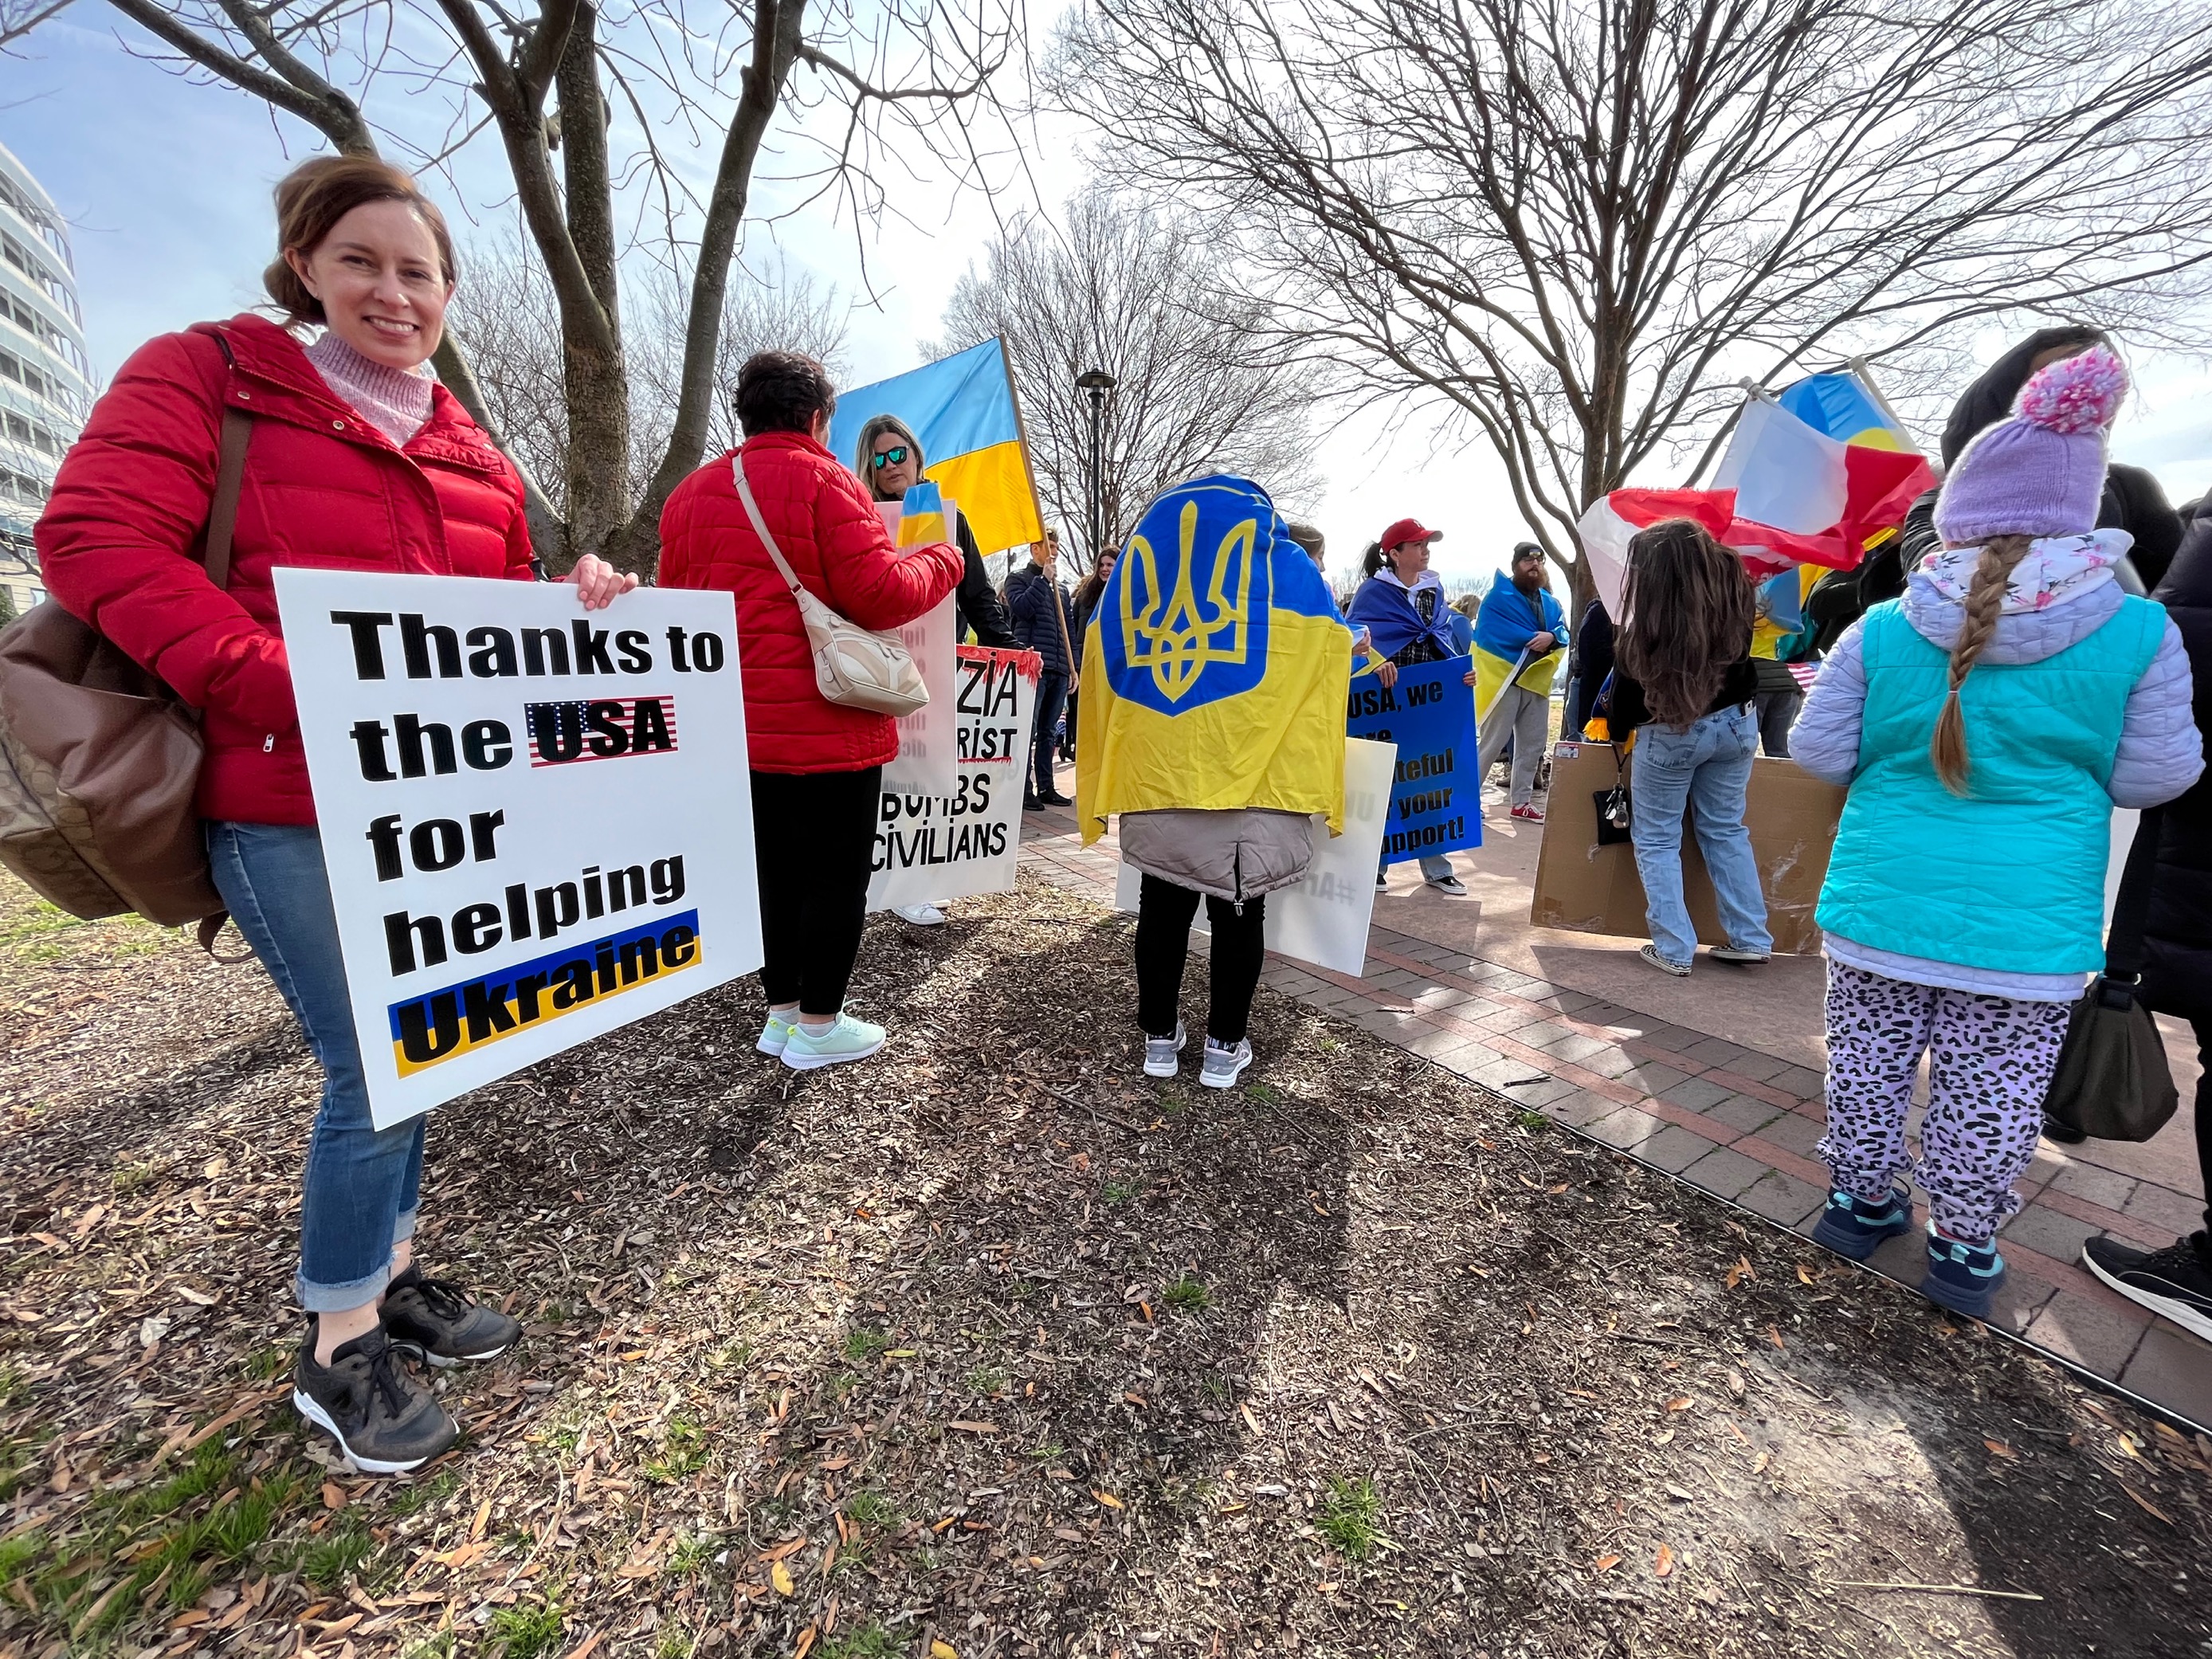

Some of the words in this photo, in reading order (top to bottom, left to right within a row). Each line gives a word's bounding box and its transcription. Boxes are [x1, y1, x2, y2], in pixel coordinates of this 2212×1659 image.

[331, 610, 653, 680] Thanks
[665, 626, 724, 673] to
[956, 652, 1018, 717] ZIA
[1406, 681, 1443, 708] we
[350, 713, 514, 782] the
[531, 699, 675, 763] USA
[957, 719, 1018, 759] RIST
[1393, 747, 1453, 783] teful
[1398, 786, 1453, 821] your
[365, 808, 505, 882] for
[871, 818, 1008, 873] CIVILIANS
[1380, 815, 1465, 856] upport!
[383, 854, 687, 977] helping
[397, 924, 697, 1064] Ukraine
